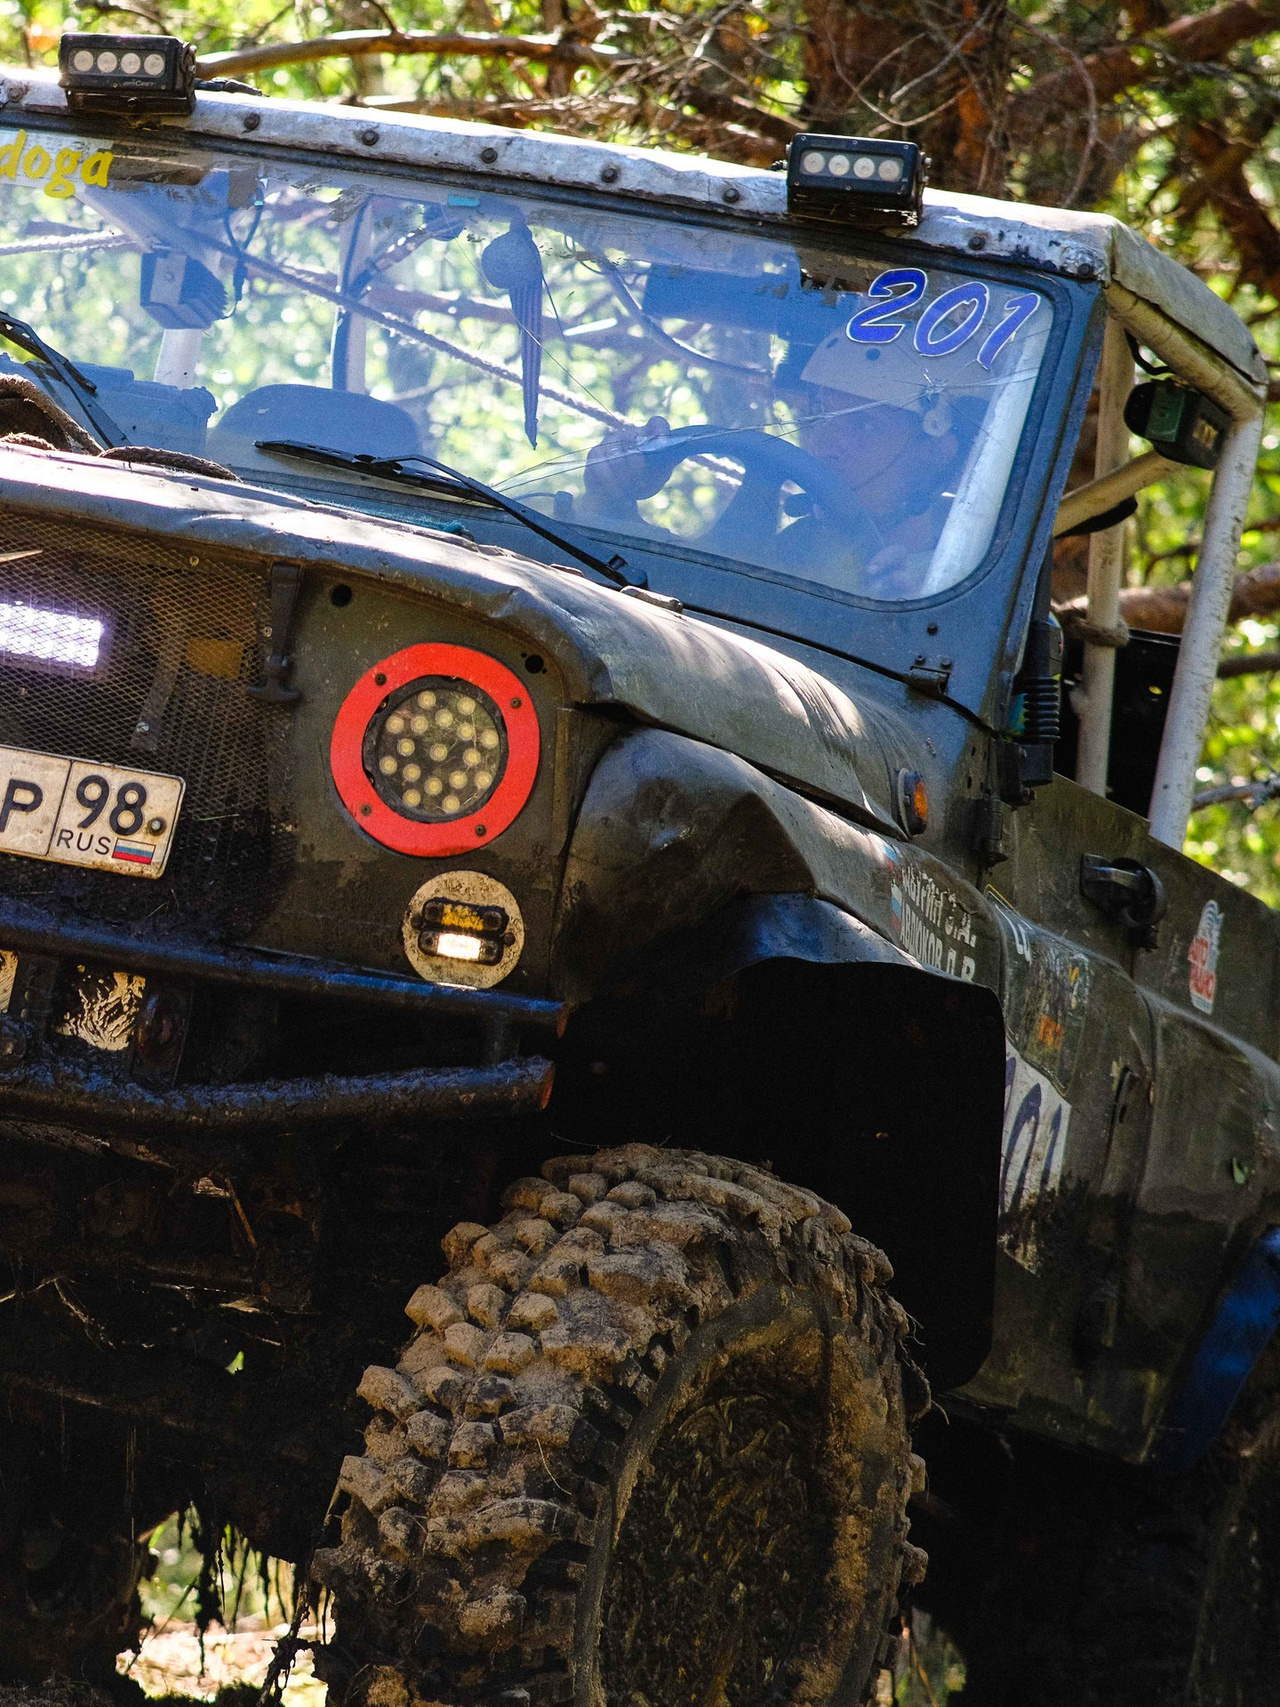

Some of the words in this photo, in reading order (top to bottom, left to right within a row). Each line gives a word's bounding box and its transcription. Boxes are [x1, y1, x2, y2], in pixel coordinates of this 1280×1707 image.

[846, 267, 1041, 370] 201
[75, 774, 149, 837] 98
[56, 829, 112, 857] RUS
